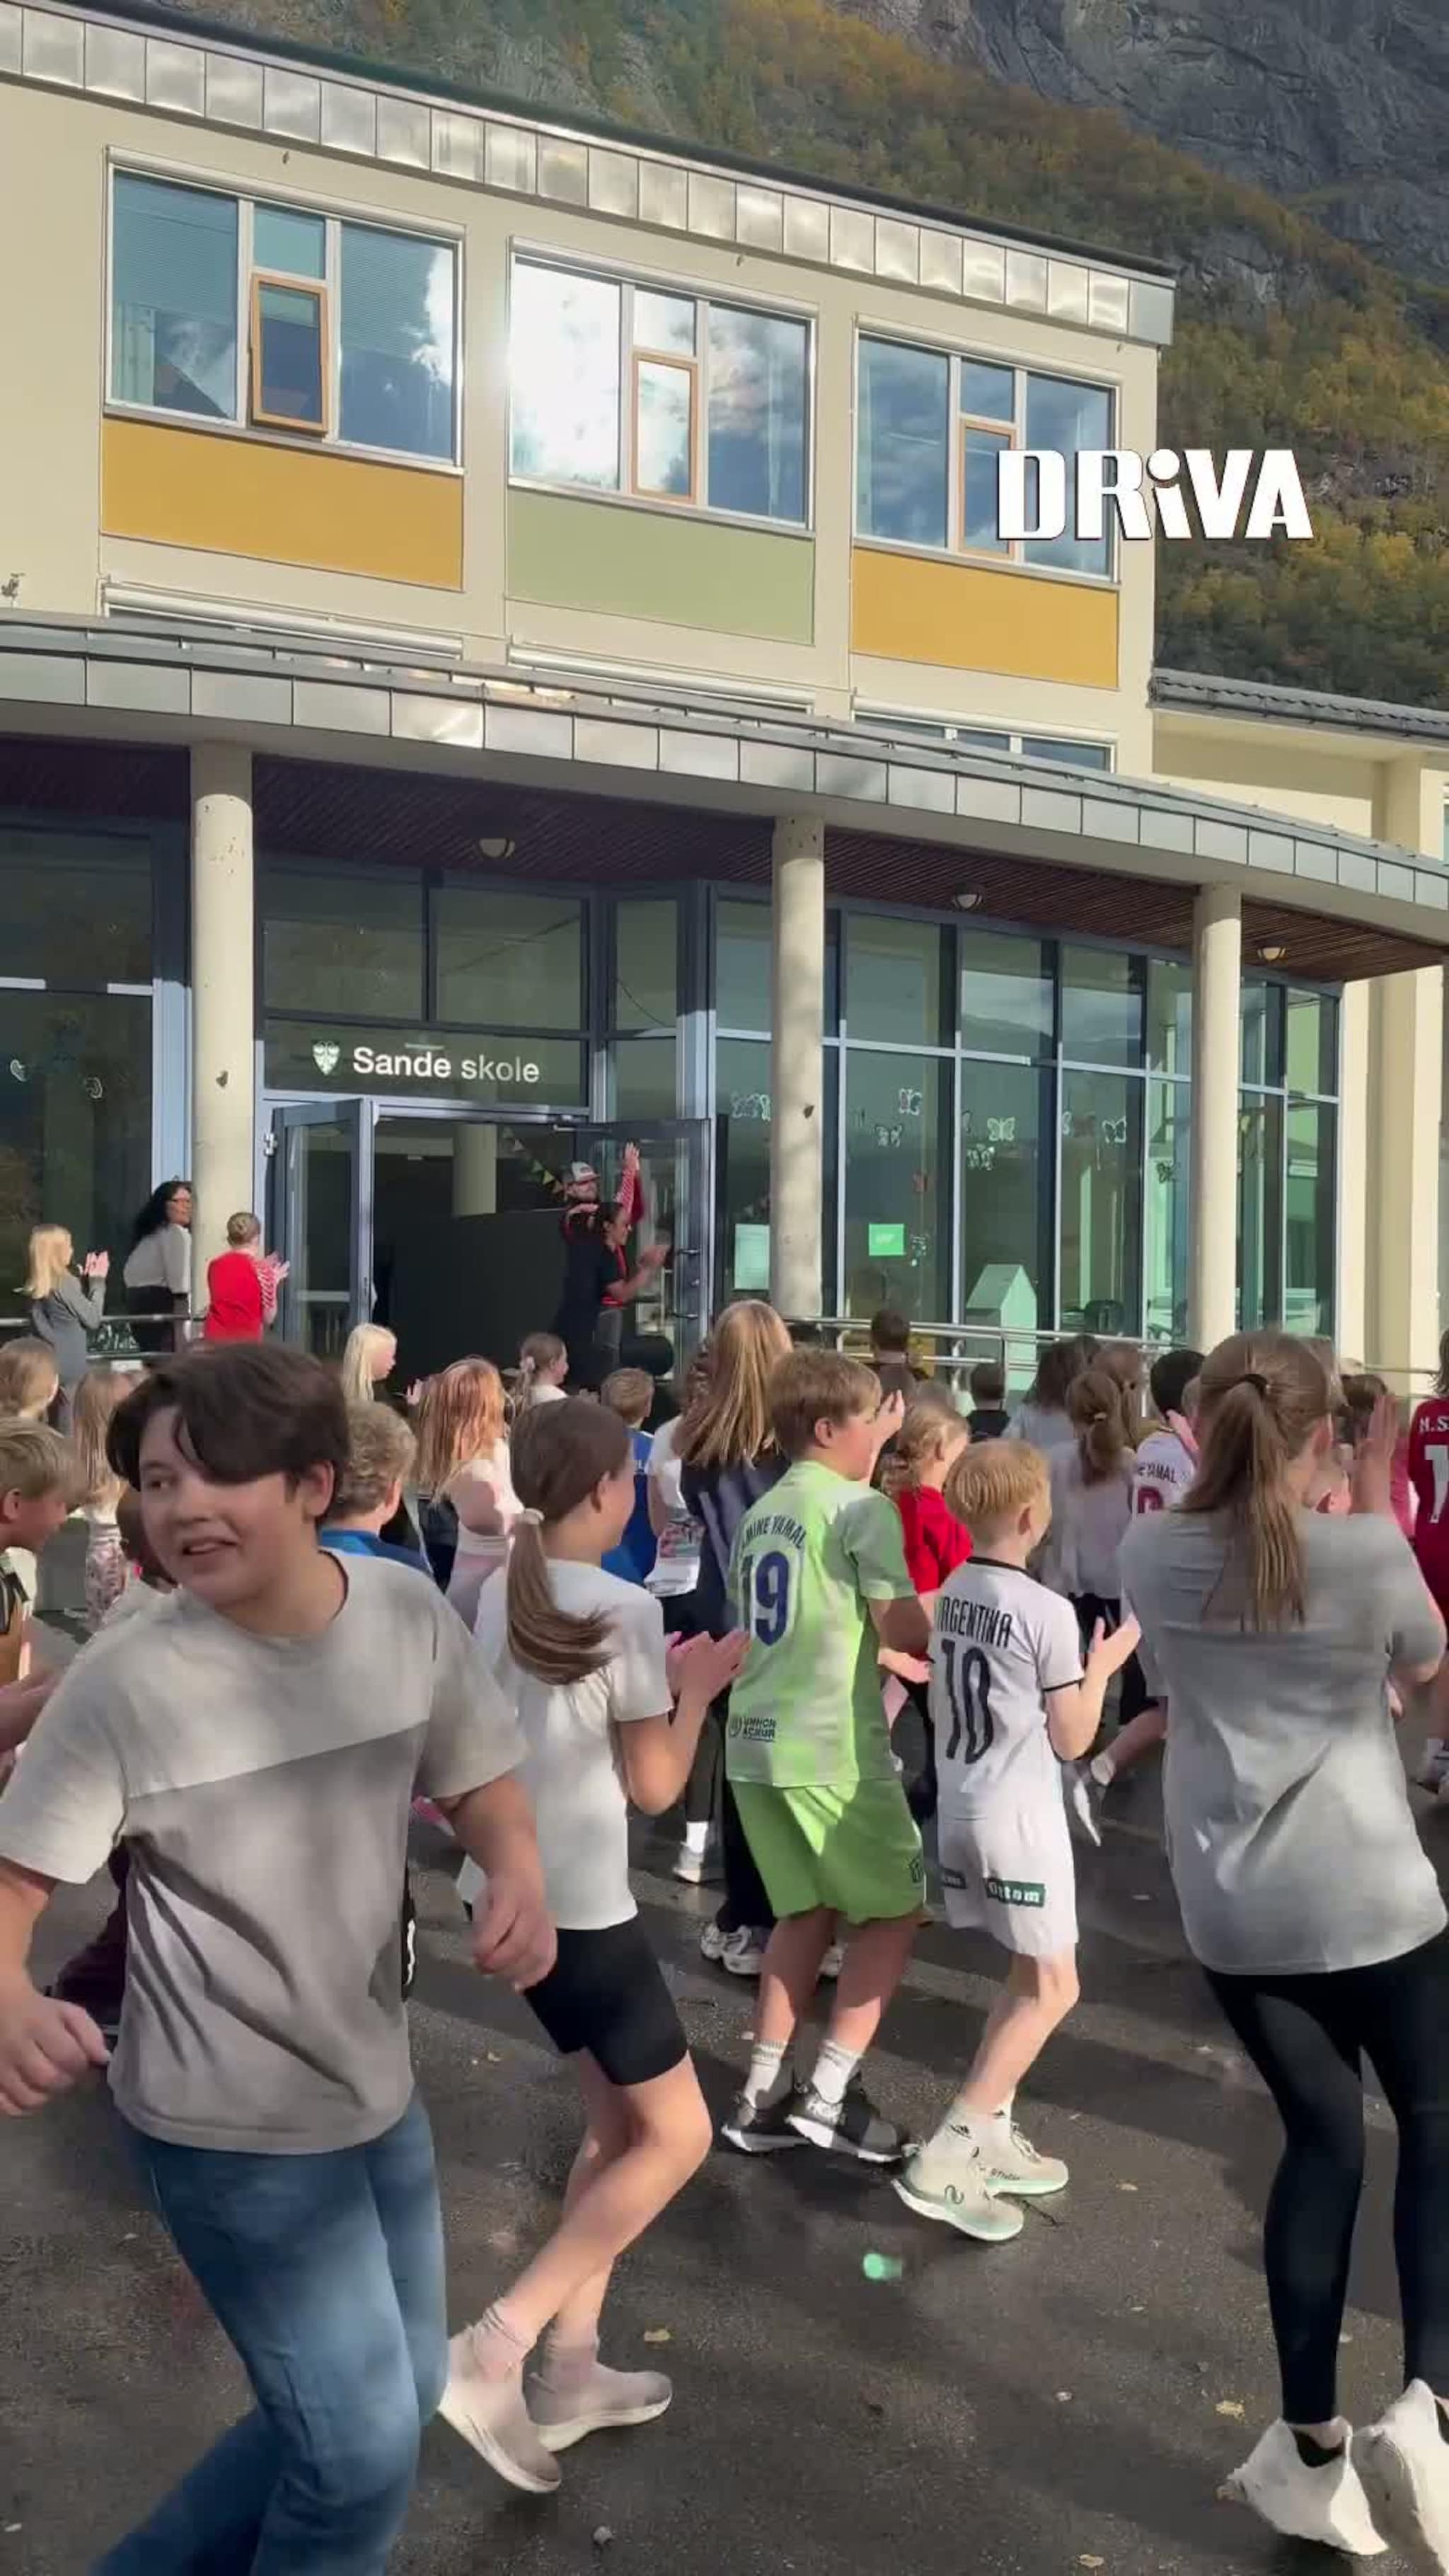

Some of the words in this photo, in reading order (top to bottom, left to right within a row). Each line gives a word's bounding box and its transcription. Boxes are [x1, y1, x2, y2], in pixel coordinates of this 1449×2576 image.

[353, 1046, 451, 1078] Sande
[461, 1055, 541, 1083] skole
[770, 1515, 807, 1549] YAMAL
[941, 1638, 994, 1765] 10
